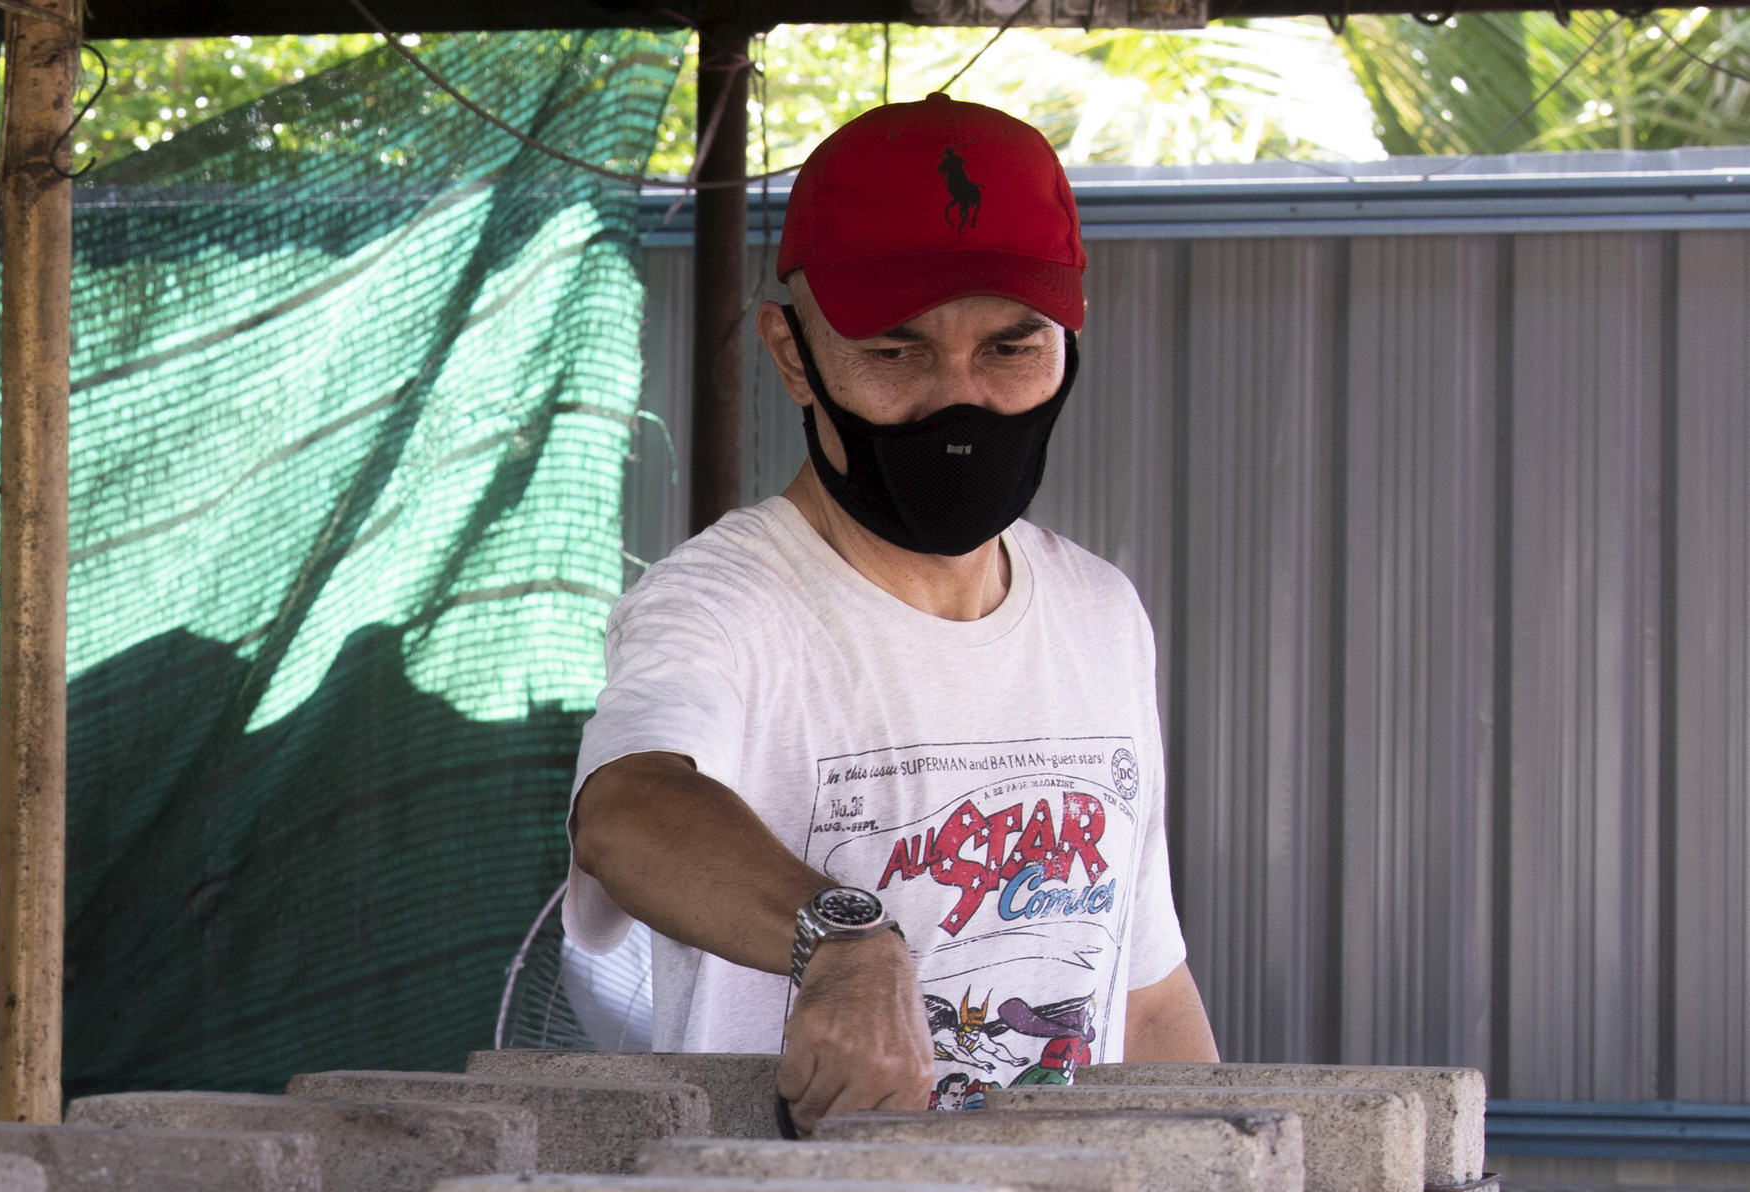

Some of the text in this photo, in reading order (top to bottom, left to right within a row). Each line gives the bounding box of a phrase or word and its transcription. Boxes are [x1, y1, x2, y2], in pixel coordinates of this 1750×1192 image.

[845, 765, 867, 782] this
[870, 765, 898, 778] issue
[901, 757, 967, 776] SUPERMAN
[969, 756, 989, 770] and
[1079, 752, 1105, 764] stars!
[1119, 767, 1133, 780] DC
[1031, 779, 1076, 789] MAGAZINE
[877, 791, 1109, 937] ALL STAR
[998, 861, 1116, 921] Comics
